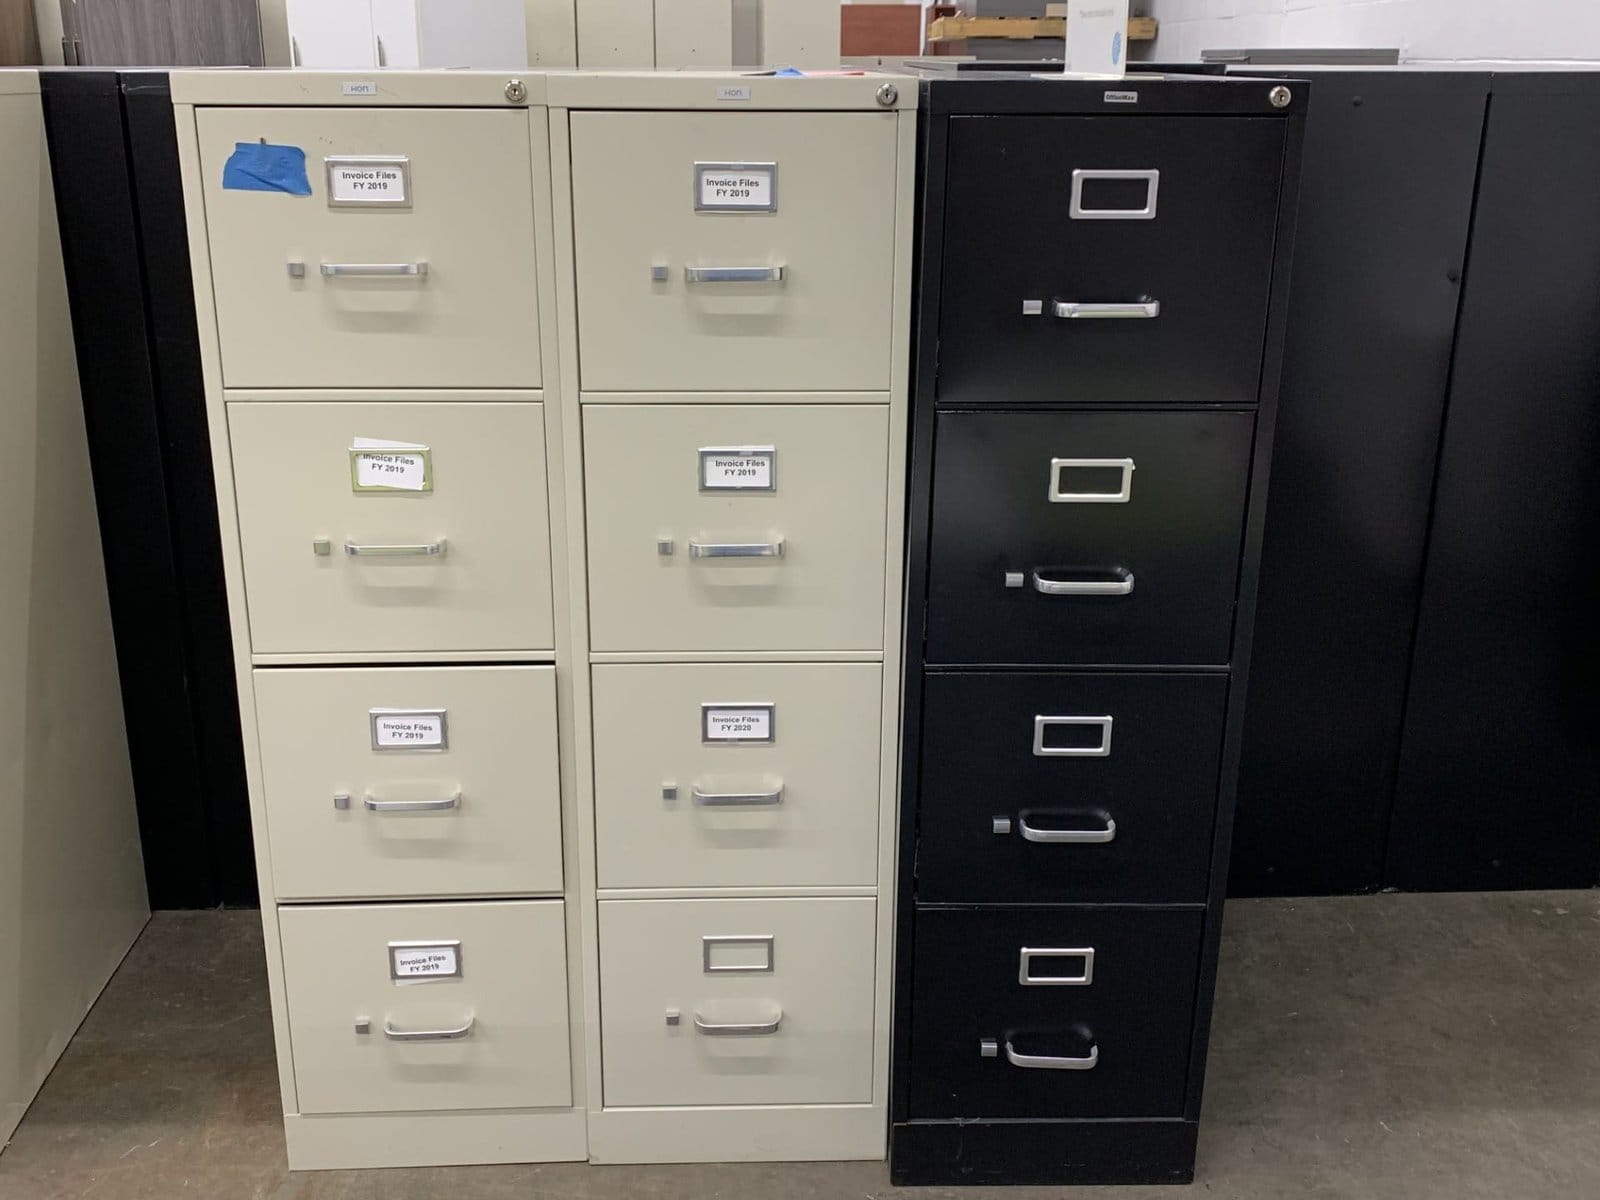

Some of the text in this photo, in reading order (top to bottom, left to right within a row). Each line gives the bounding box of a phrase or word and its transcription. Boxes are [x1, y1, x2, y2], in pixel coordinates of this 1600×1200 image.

[342, 171, 397, 180] Invoice Files
[353, 182, 388, 190] FY 2019
[706, 178, 760, 187] Invoice Files
[716, 189, 750, 197] FY 2019
[363, 453, 415, 466] Invoice Files
[715, 459, 766, 468] Invoice Files
[371, 463, 405, 474] FY 2019
[712, 716, 740, 724] Invoice
[383, 722, 433, 731] Invoice Files
[733, 724, 752, 732] 2020
[391, 731, 403, 739] FY
[400, 957, 427, 967] Invoice
[421, 963, 440, 972] 2019
